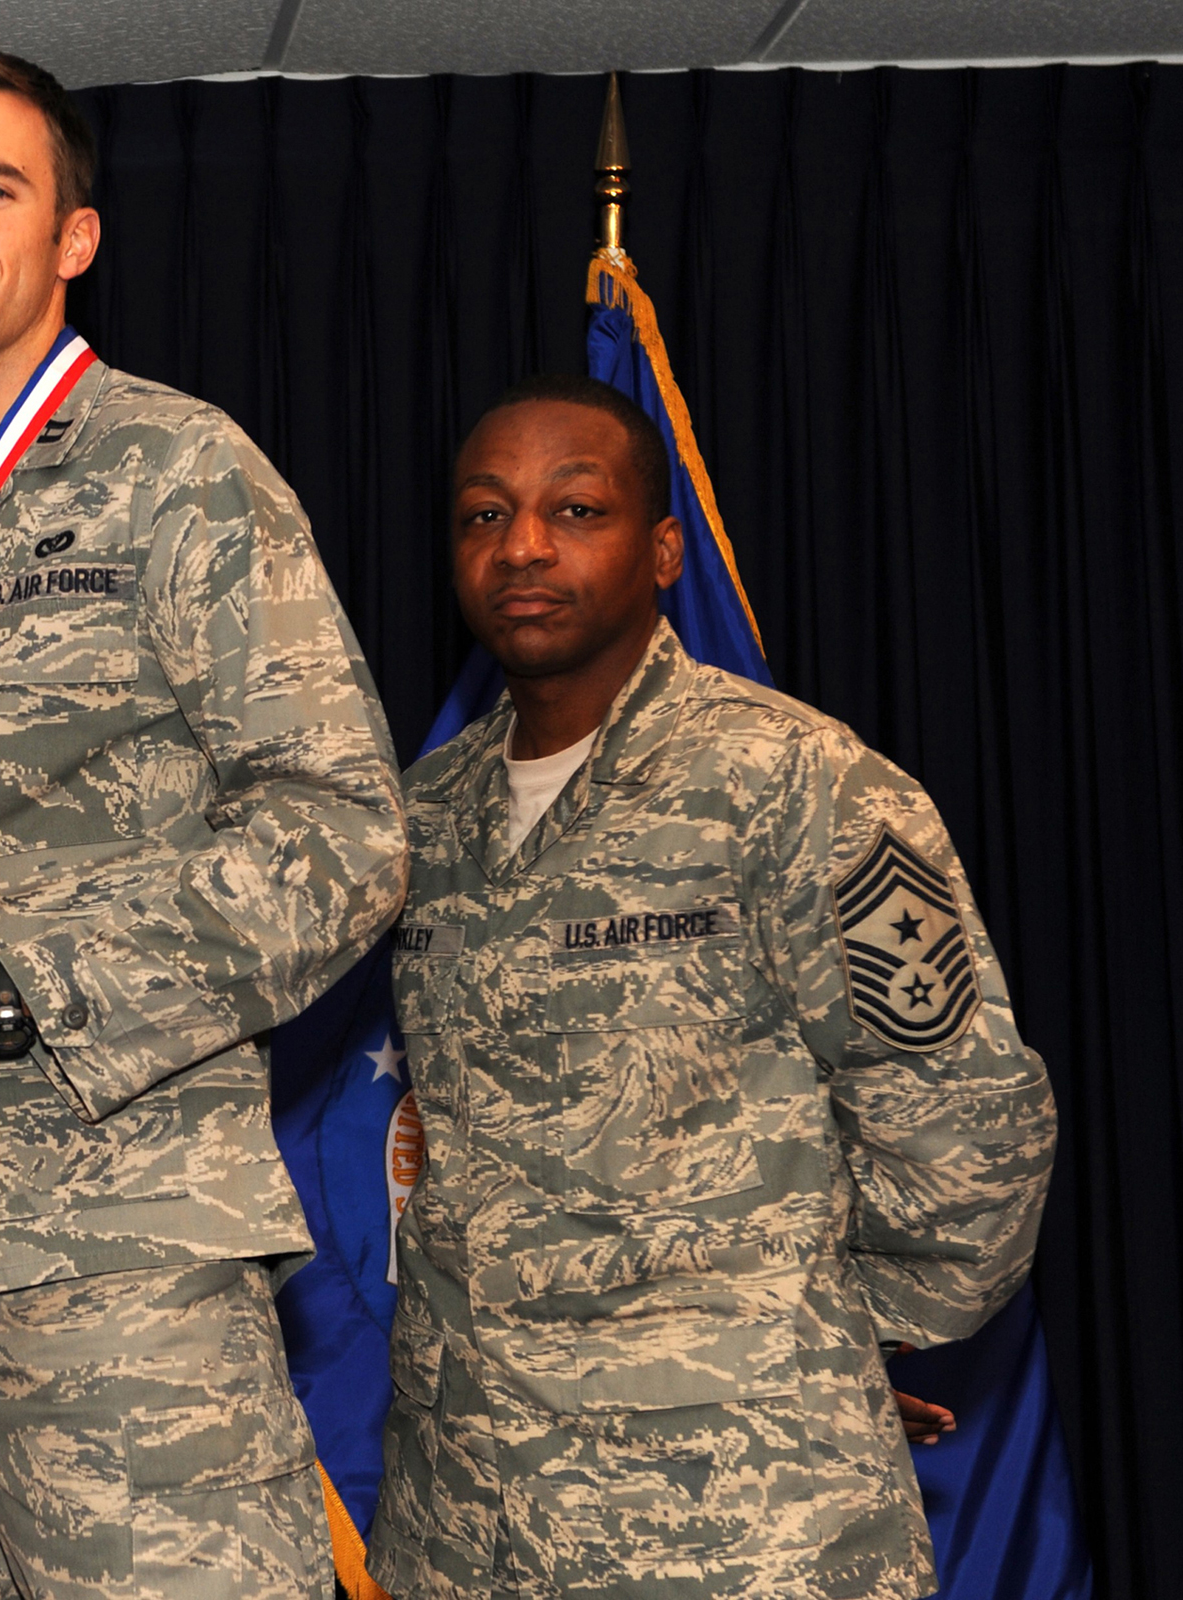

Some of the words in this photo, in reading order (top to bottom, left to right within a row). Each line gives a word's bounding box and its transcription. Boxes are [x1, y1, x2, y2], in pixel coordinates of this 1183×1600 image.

[9, 573, 42, 600] AIR
[46, 567, 119, 595] FORCE
[565, 923, 600, 949] U.S.
[604, 917, 640, 945] AIR
[644, 910, 718, 941] FORCE
